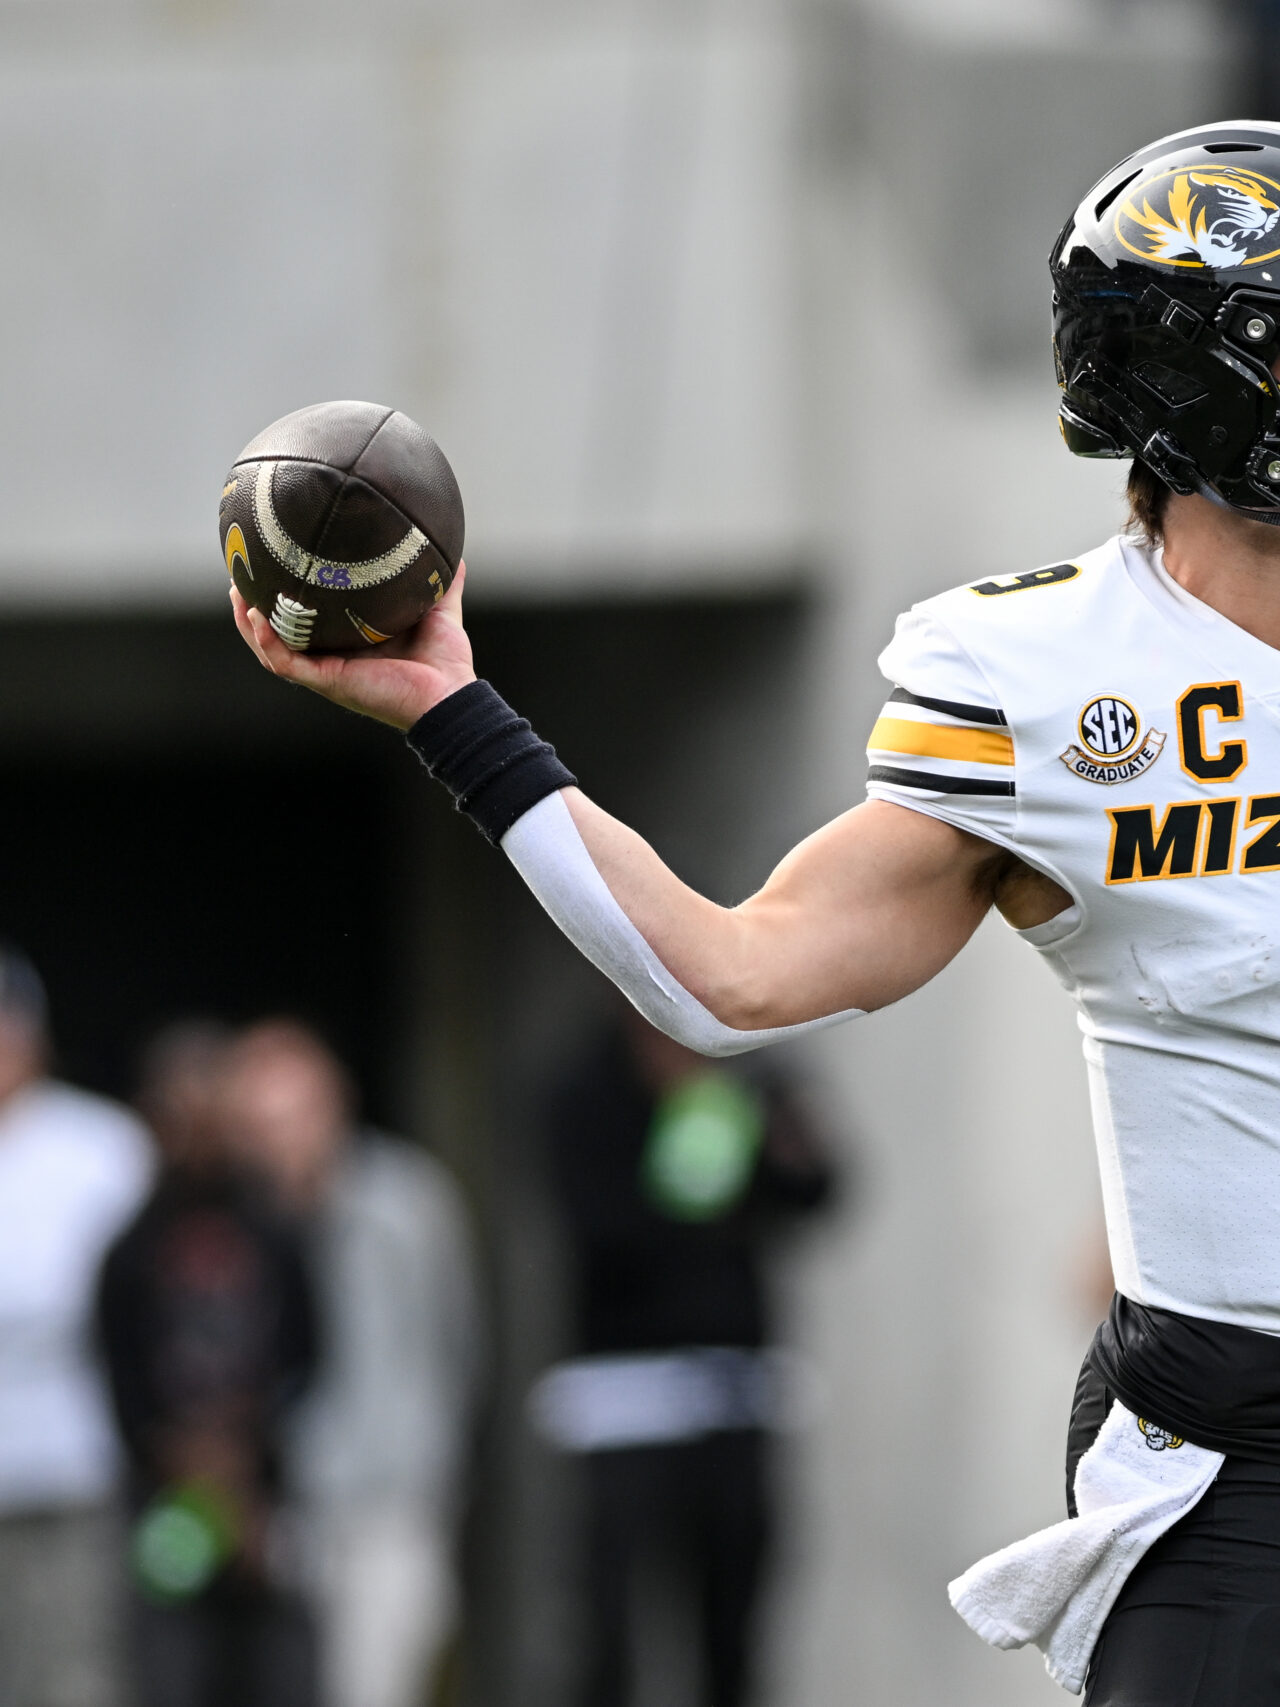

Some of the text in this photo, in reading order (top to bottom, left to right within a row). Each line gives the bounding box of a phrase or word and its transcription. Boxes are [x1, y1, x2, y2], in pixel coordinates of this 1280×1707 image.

[1082, 699, 1135, 754] SEC
[1175, 680, 1247, 784] C
[1075, 747, 1155, 782] GRADUATE
